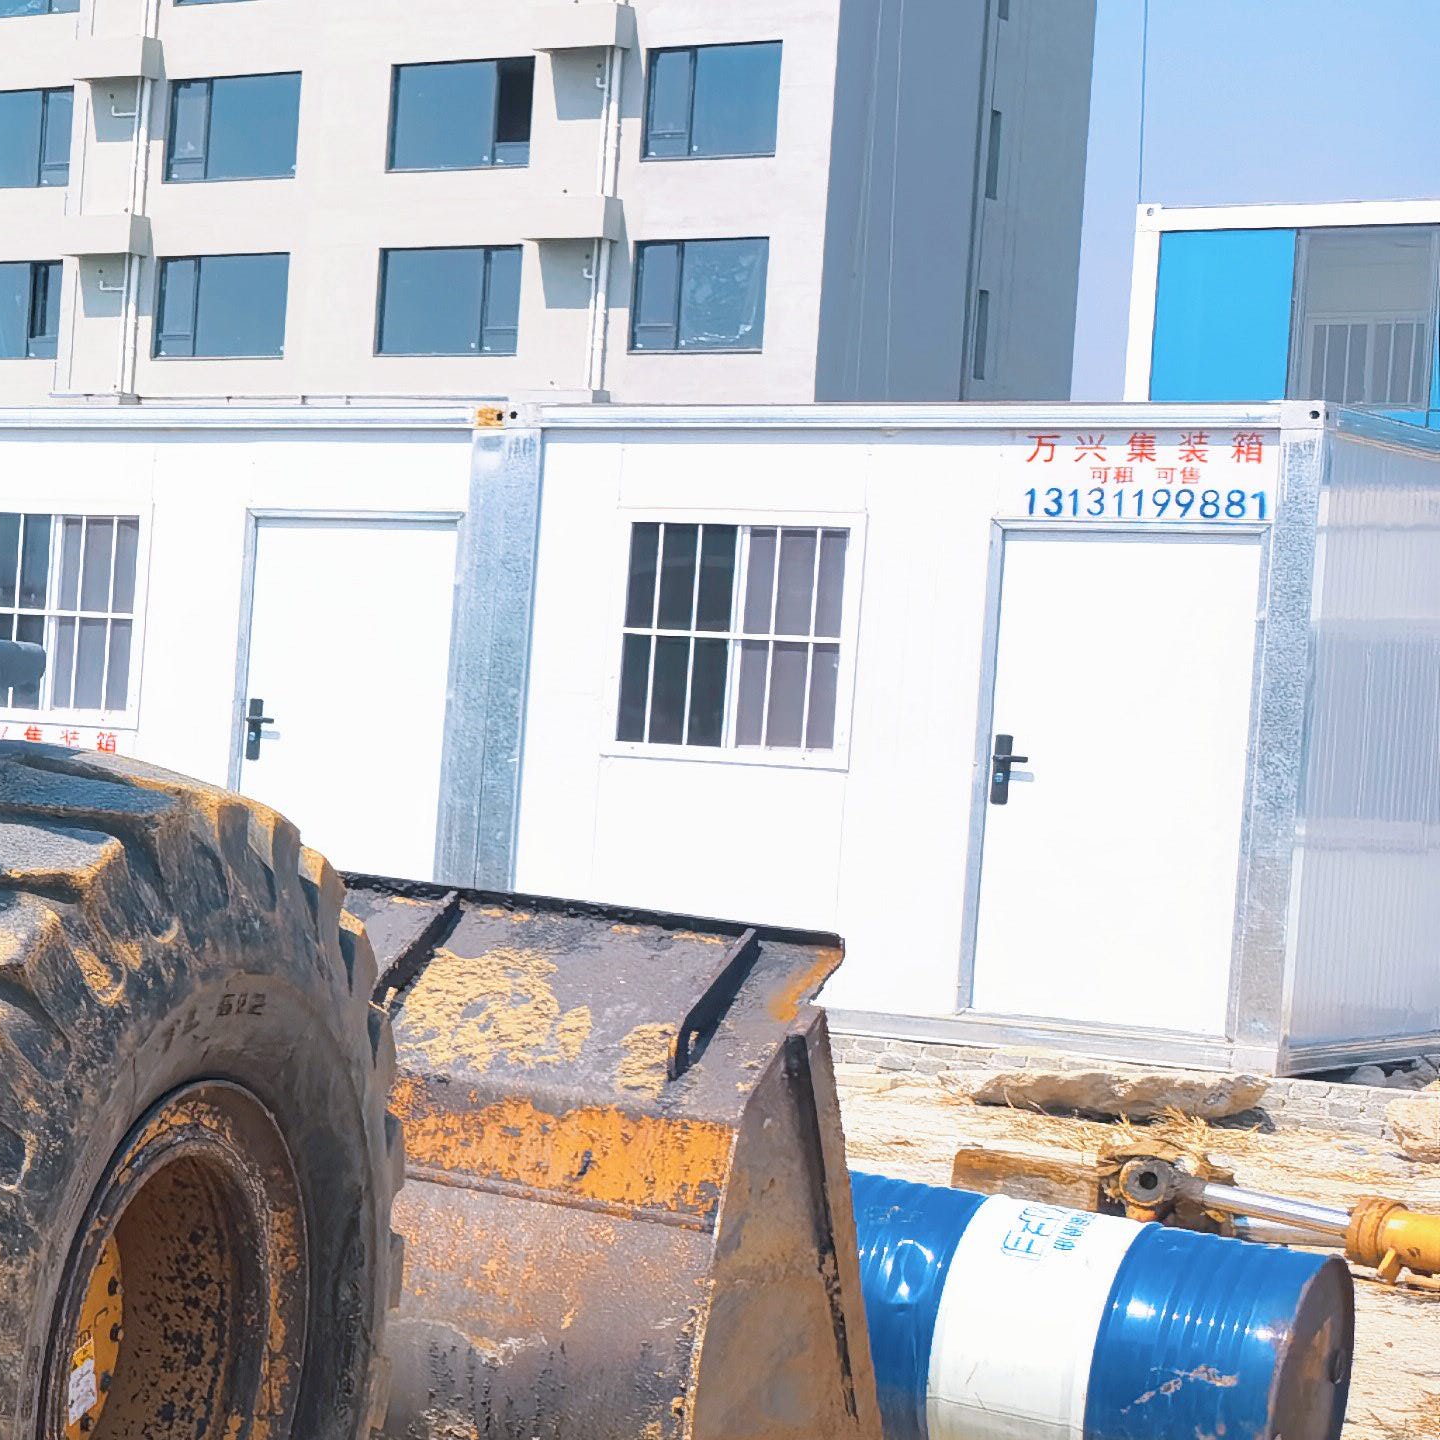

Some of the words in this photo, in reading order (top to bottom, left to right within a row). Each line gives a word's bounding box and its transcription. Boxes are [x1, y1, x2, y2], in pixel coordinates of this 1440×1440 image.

[1025, 431, 1263, 465] 万兴集装箱
[1089, 466, 1135, 483] 可租
[1155, 466, 1202, 485] 可售
[1024, 486, 1268, 520] 13131199881
